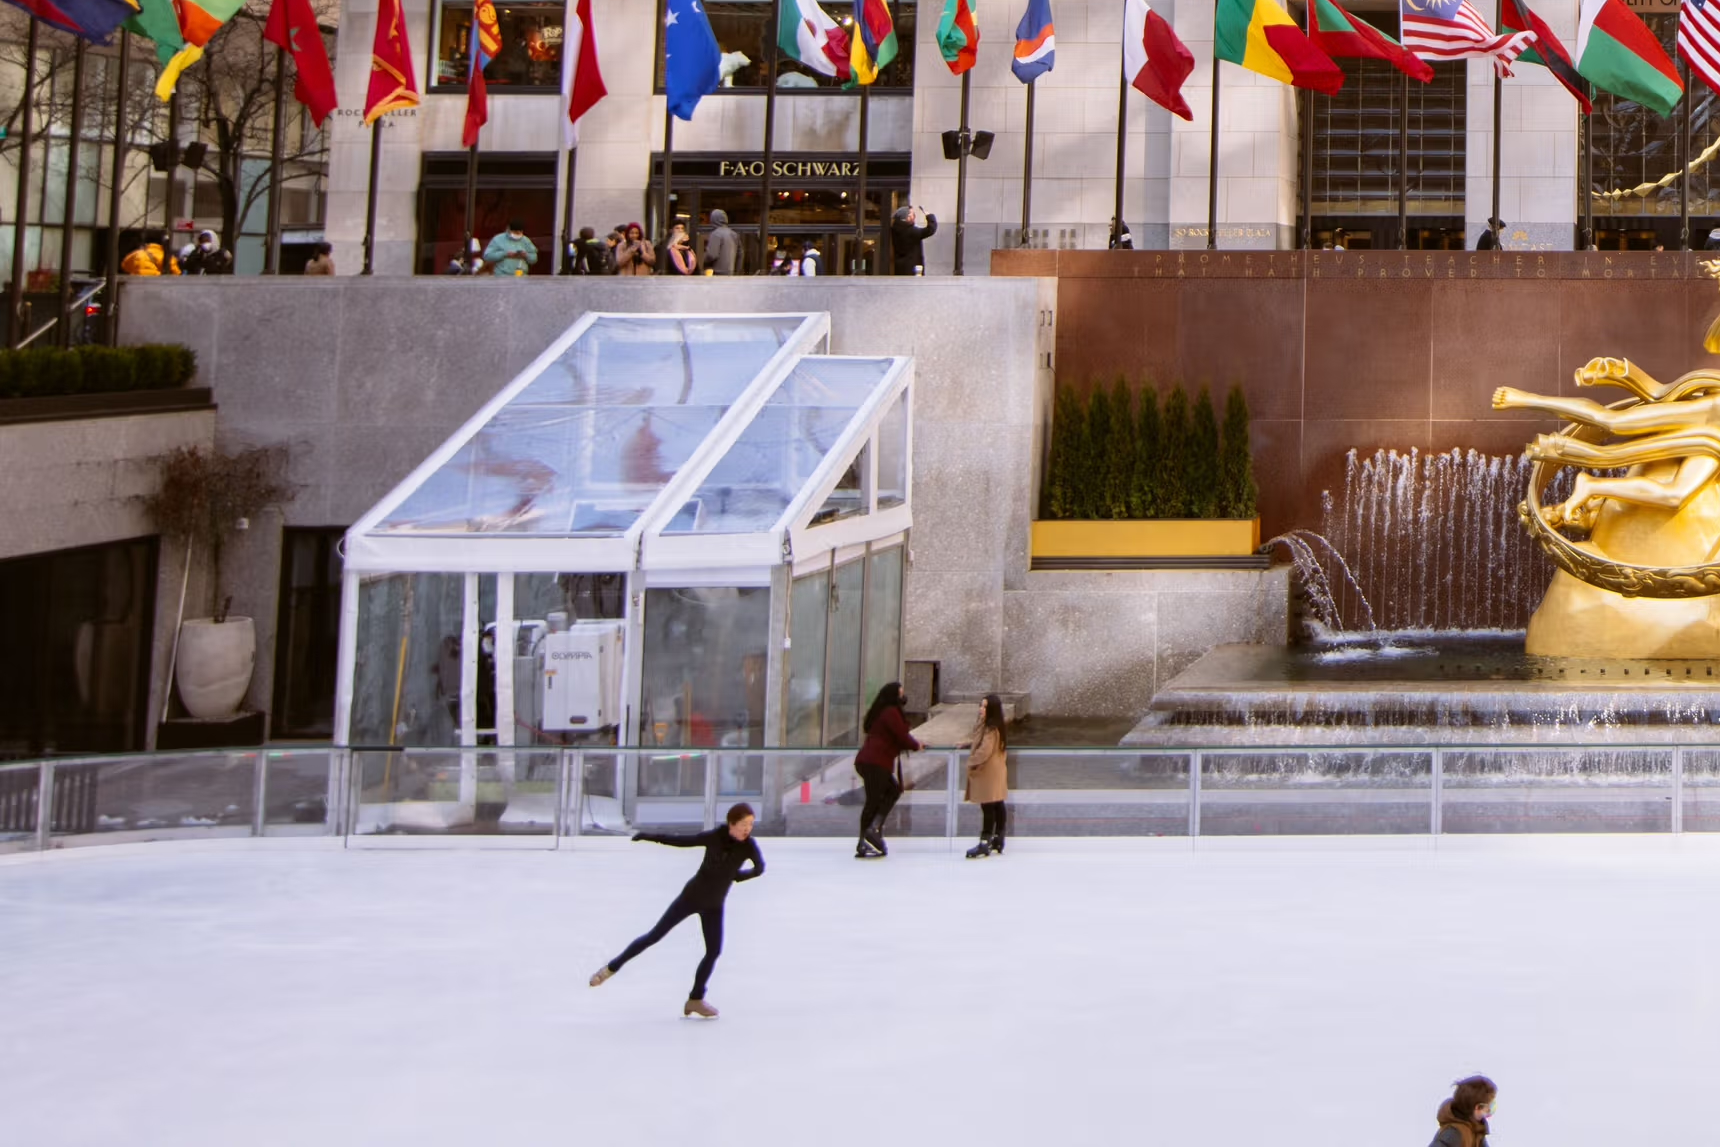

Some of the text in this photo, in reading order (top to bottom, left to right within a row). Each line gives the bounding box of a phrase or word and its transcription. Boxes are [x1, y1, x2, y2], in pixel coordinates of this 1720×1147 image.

[771, 161, 860, 176] SCHWARZ
[1156, 254, 1365, 264] PROMETHEUS
[1404, 254, 1546, 264] TEACHER
[1583, 254, 1613, 265] IN
[1133, 267, 1208, 277] THAT
[1245, 267, 1321, 277] HATH
[1357, 267, 1478, 277] PROVED
[1516, 267, 1547, 278] TO
